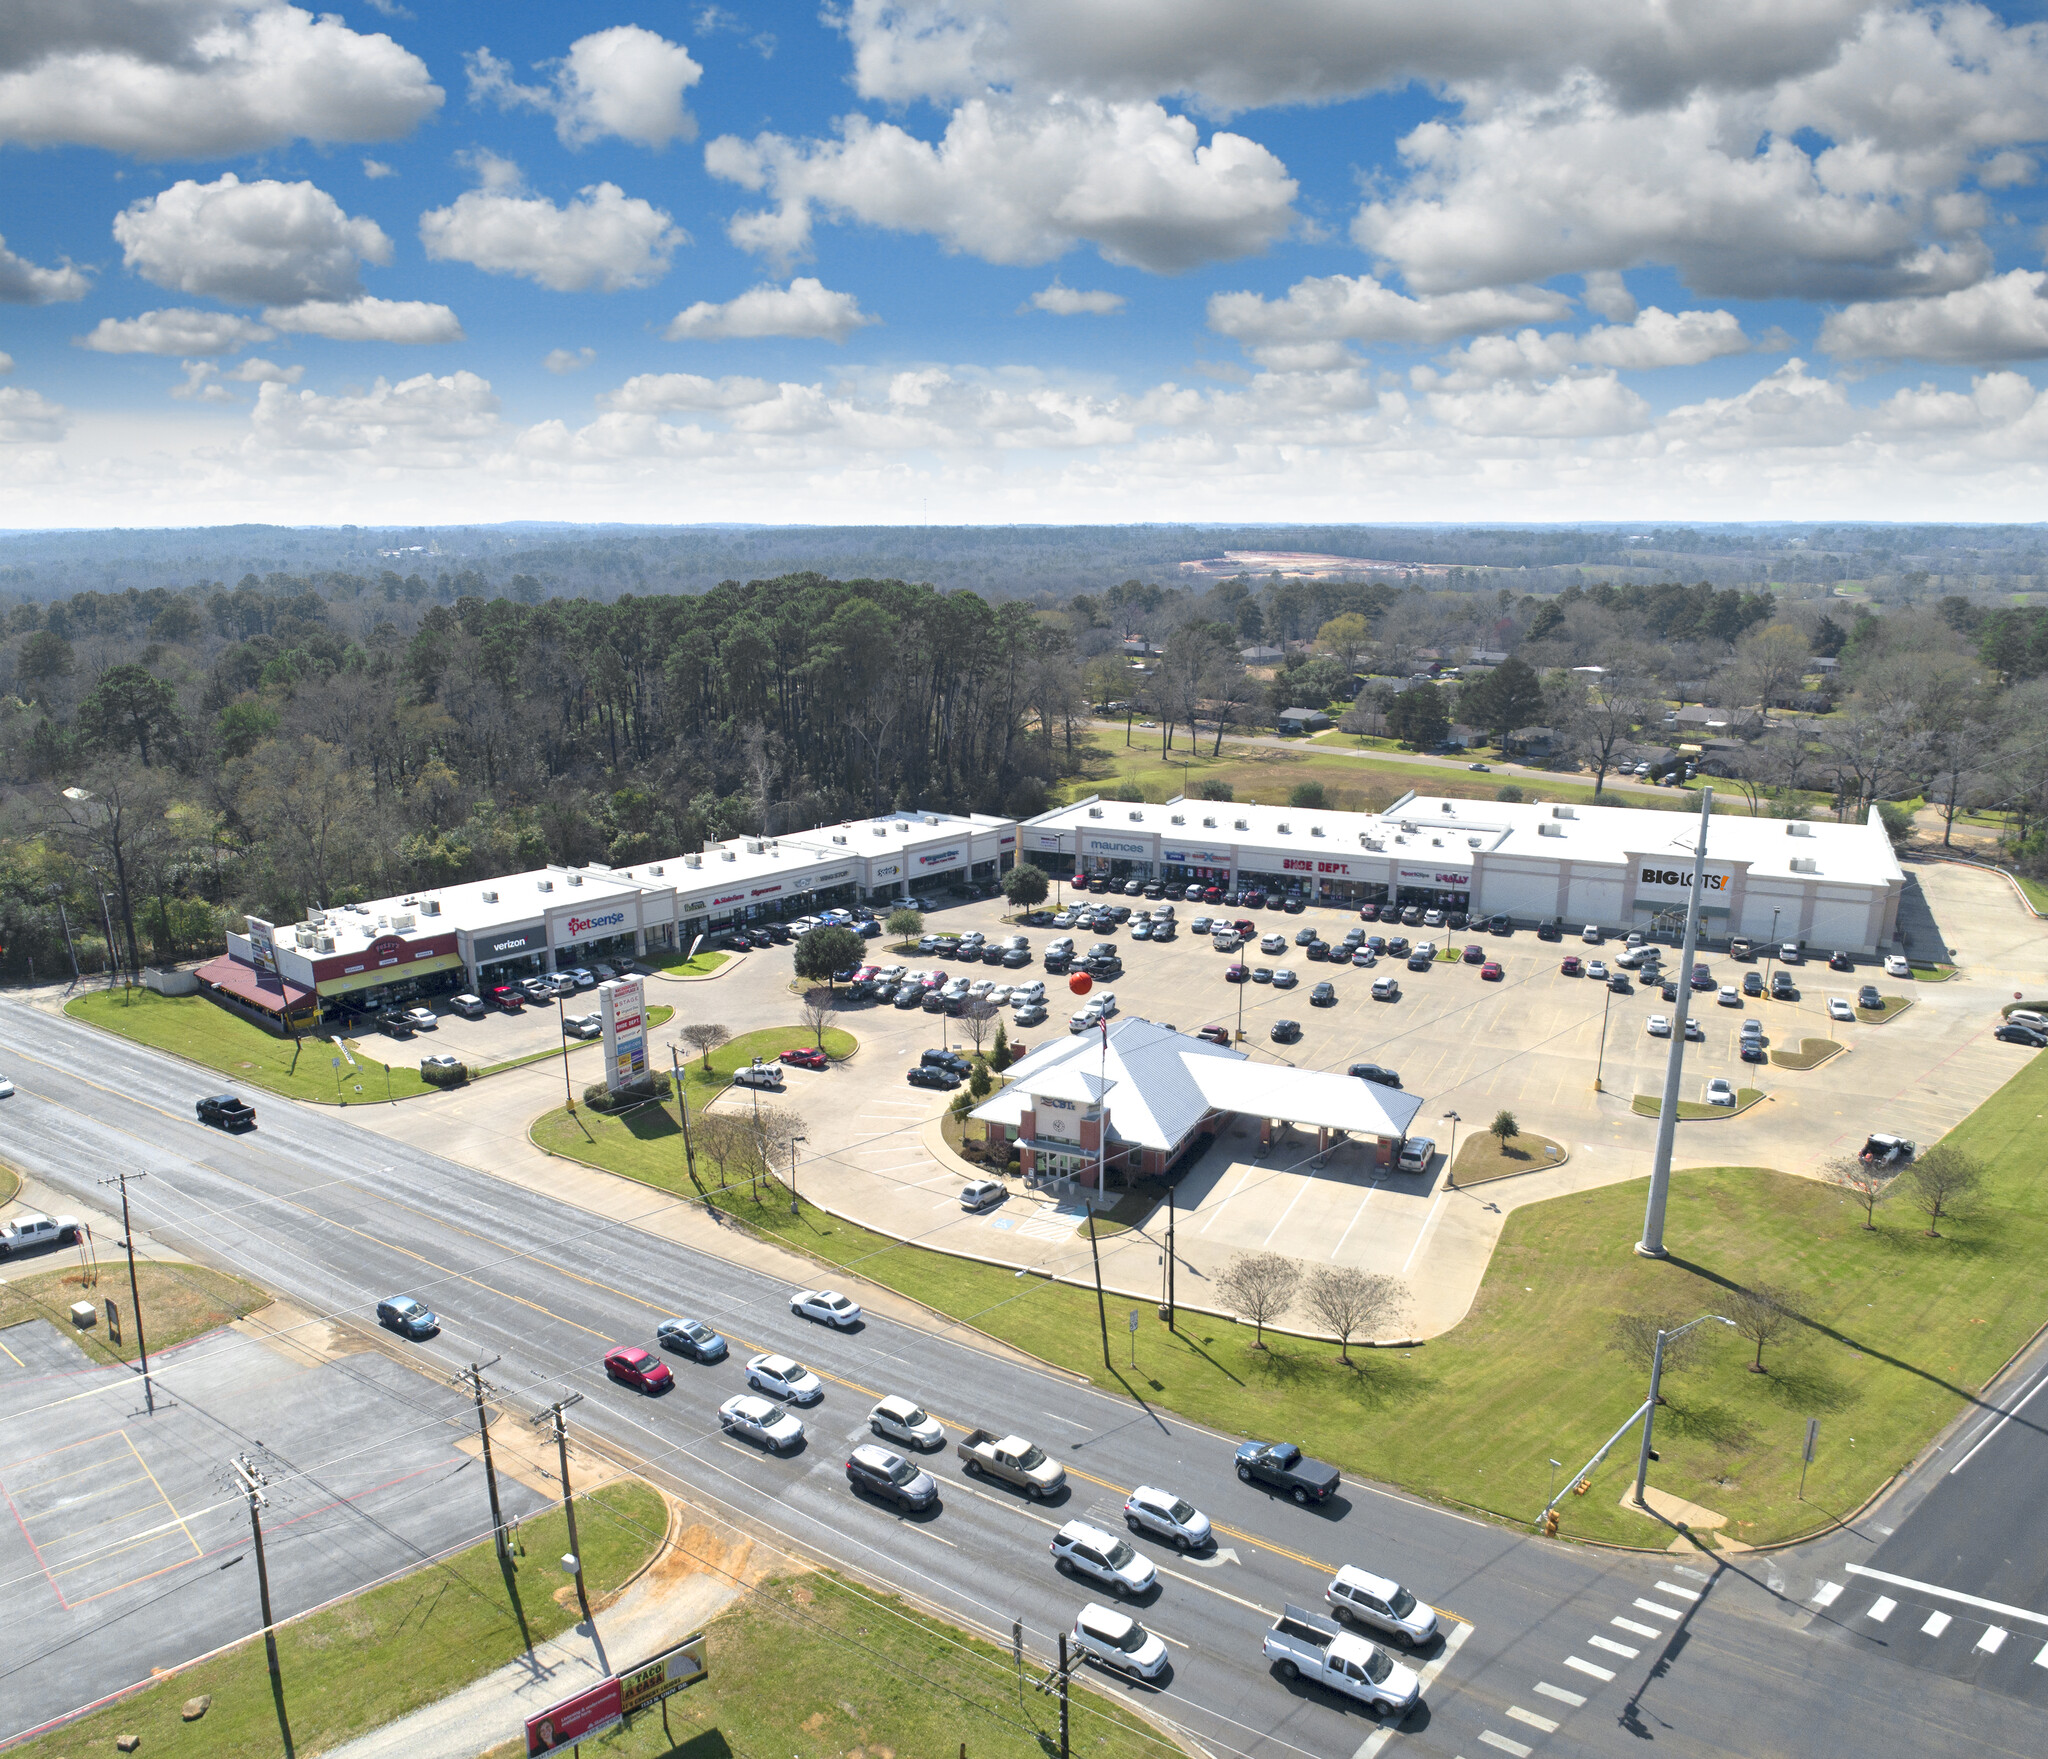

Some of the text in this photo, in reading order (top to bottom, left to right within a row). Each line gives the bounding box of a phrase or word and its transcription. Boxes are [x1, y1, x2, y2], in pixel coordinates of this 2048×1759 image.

[1090, 840, 1144, 853] maurices
[1283, 858, 1350, 875] SHOE DEPT.
[1641, 868, 1680, 885] BIG
[493, 938, 526, 951] verizon
[619, 995, 639, 1006] STAGE
[635, 1664, 662, 1682] TACO
[635, 1674, 662, 1693] CASA
[641, 1700, 653, 1708] 1133
[660, 1689, 677, 1699] UNIV.
[677, 1682, 688, 1690] DR.
[560, 1710, 581, 1722] Listening
